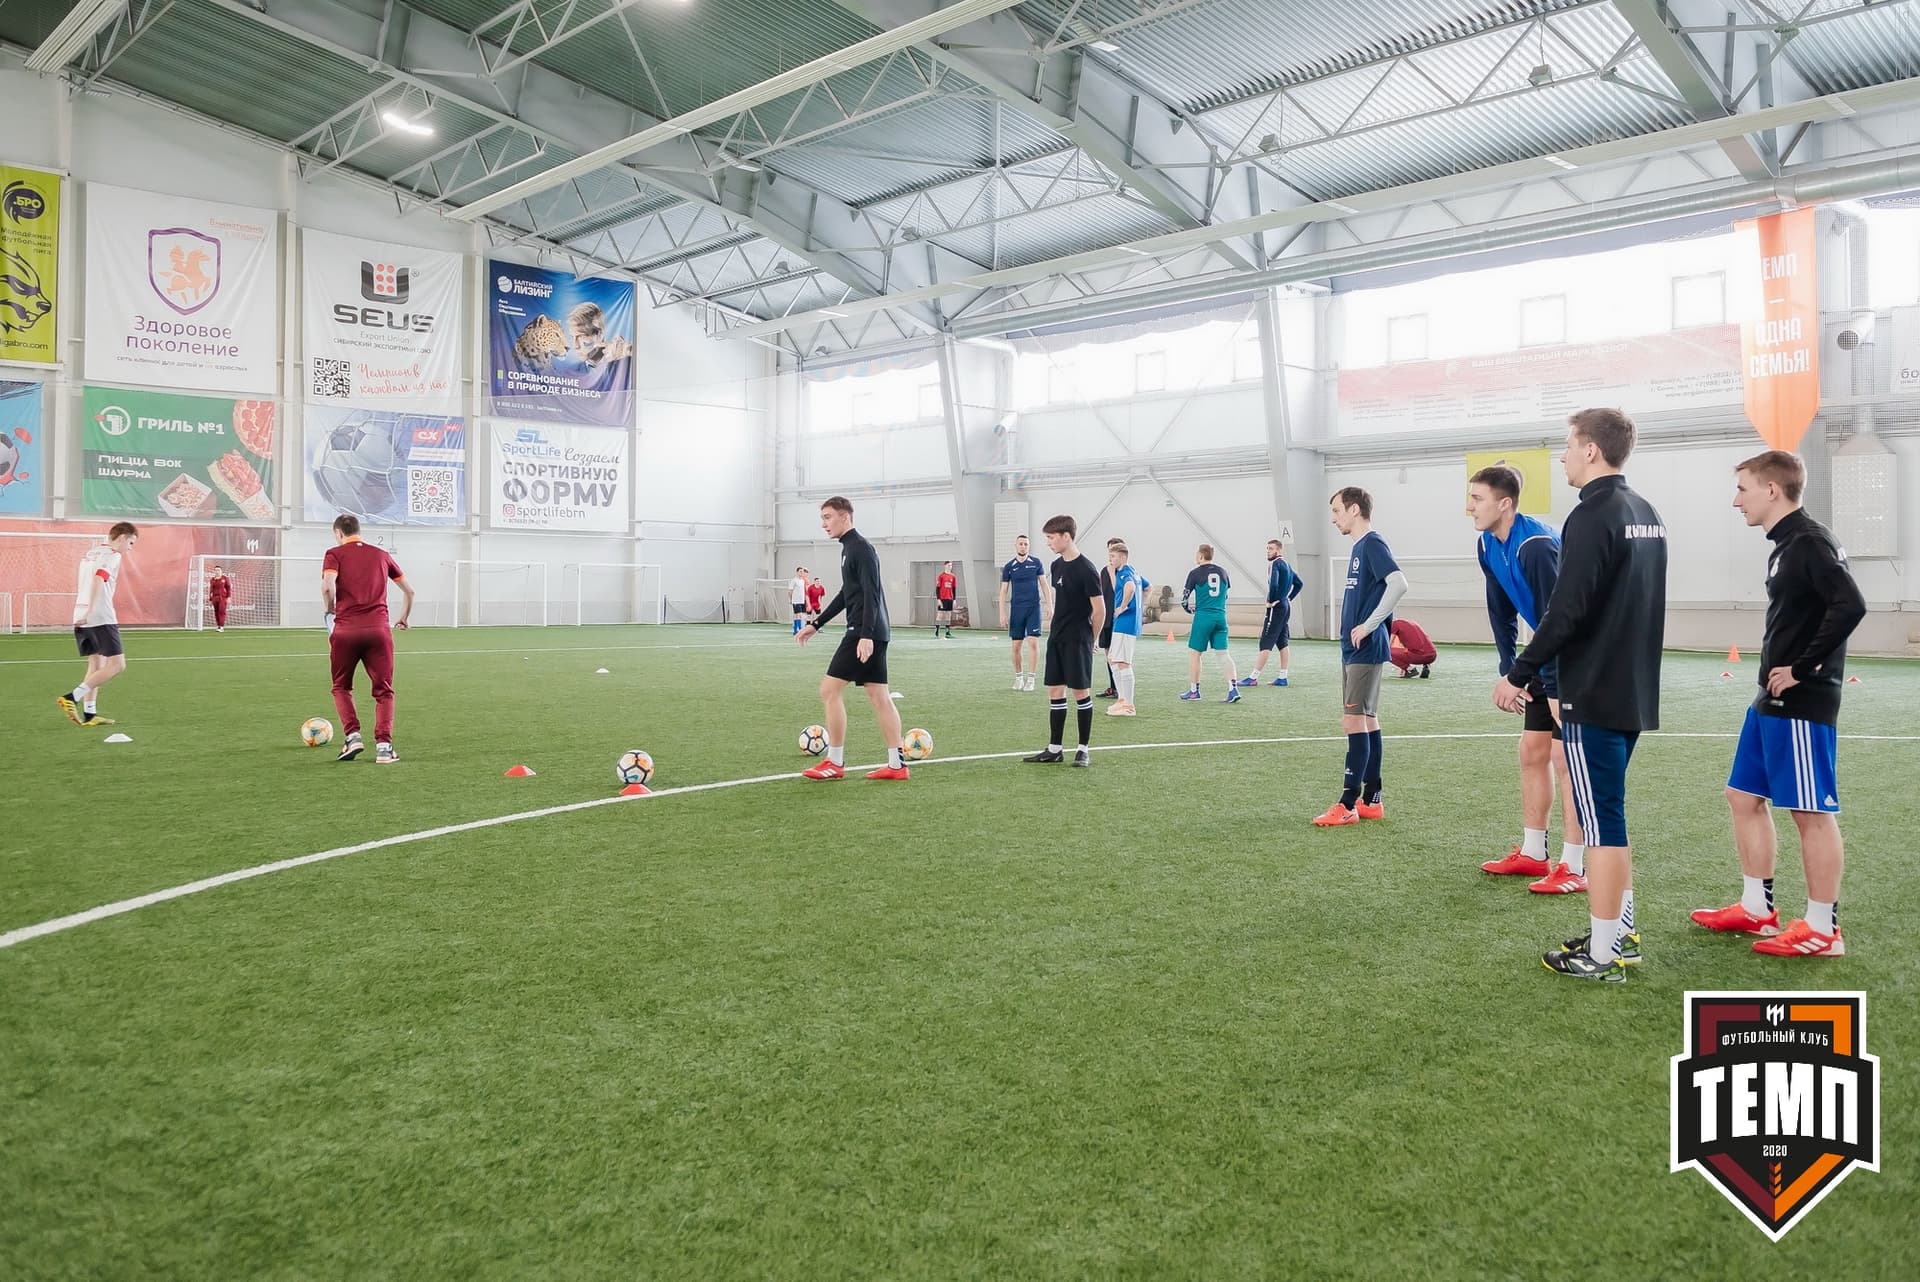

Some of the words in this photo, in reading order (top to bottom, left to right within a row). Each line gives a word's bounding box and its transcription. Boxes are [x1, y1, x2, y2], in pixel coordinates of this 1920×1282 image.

[1762, 253, 1797, 281] ЕМП
[513, 285, 553, 298] ЛИЗИНГ
[134, 315, 232, 339] Здоровое
[333, 303, 435, 334] SEUS
[360, 331, 385, 342] Export
[387, 335, 410, 345] Union
[1755, 317, 1802, 347] ОДНА
[126, 335, 240, 357] поколение
[1750, 348, 1810, 378] СЕМЬЯ!
[507, 371, 580, 387] СОРЕВНОВАНИЕ
[507, 381, 515, 389] В
[516, 382, 560, 394] ПРИРОДЕ
[561, 387, 602, 398] БИЗНЕСА
[138, 416, 194, 433] ГРИЛЬ
[198, 422, 225, 435] №1
[502, 443, 561, 457] SportLife
[564, 447, 620, 466] Создаем
[98, 454, 149, 468] ПИЦЦА
[153, 458, 182, 468] ВОК
[98, 467, 152, 479] ШАУРМА
[502, 461, 618, 481] СПОРТИВНУЮ
[502, 478, 617, 507] ФОРМУ
[516, 507, 586, 519] sportlifebrn
[377, 535, 384, 546] 2
[1208, 573, 1221, 598] 9
